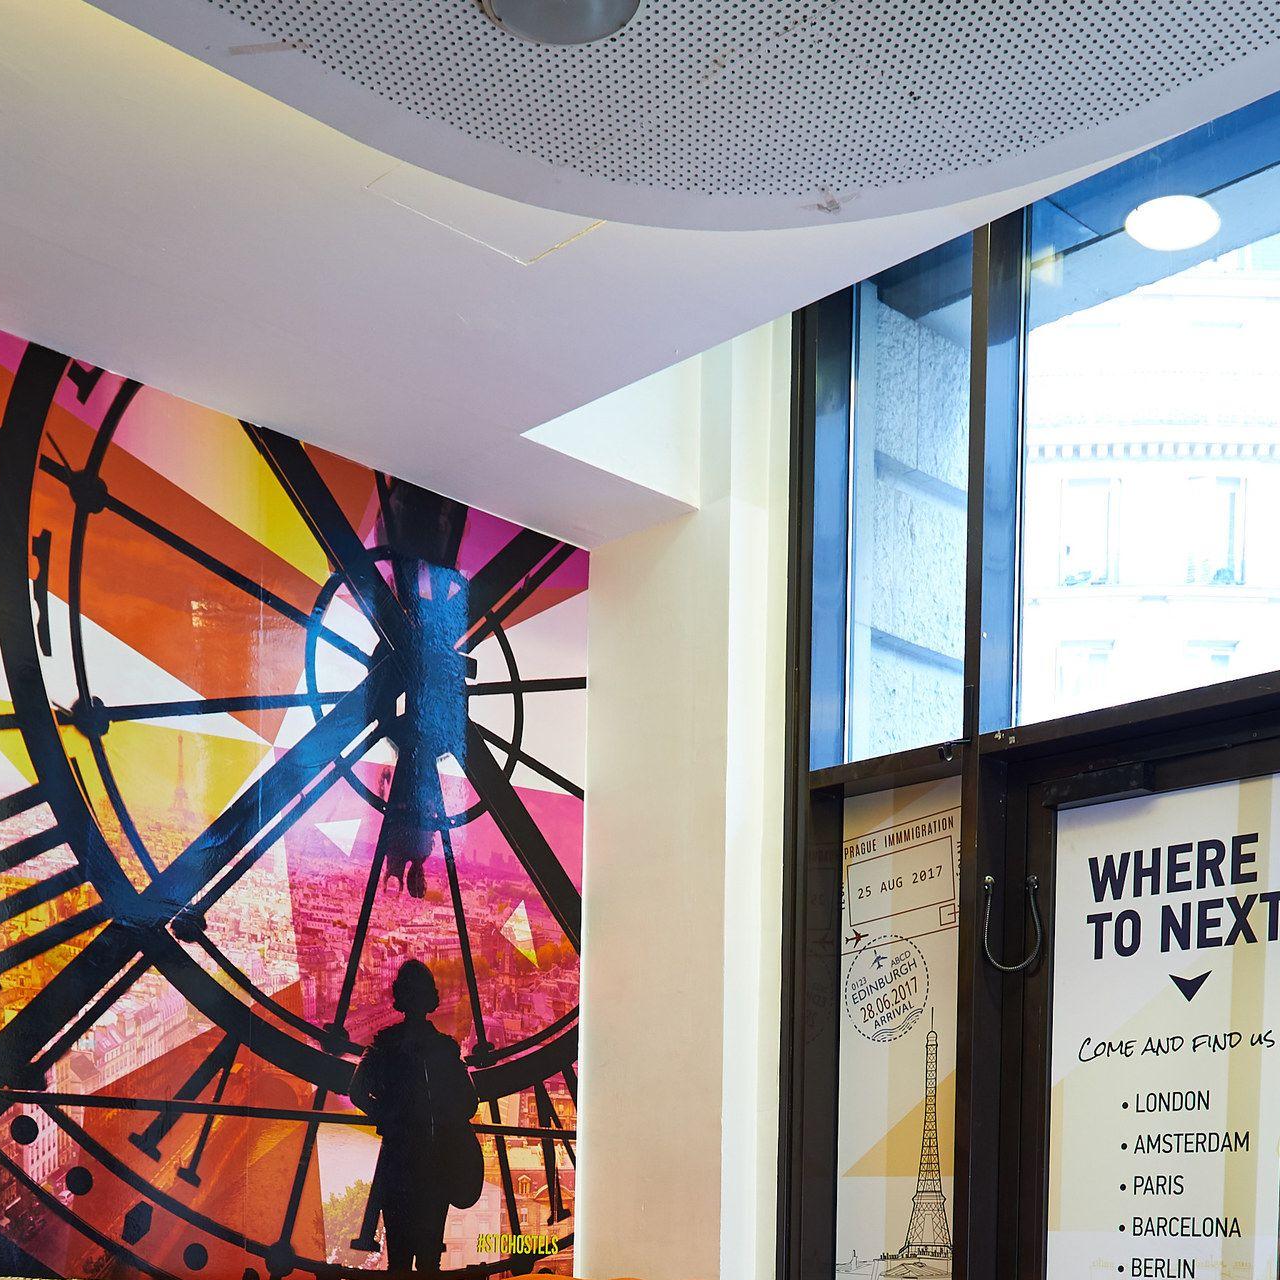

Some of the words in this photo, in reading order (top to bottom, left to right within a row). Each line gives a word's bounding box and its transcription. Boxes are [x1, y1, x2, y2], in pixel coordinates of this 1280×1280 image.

[844, 838, 876, 860] PRAGUE
[1087, 832, 1259, 903] WHERE
[858, 886, 872, 900] 25
[880, 877, 903, 893] AUG
[912, 865, 943, 884] 2017
[1086, 909, 1142, 960] TO
[890, 950, 911, 967] ABCD
[851, 957, 918, 1005] EDINBURGH
[851, 976, 867, 990] 0123
[860, 976, 920, 1024] 28.06.2017
[874, 1001, 914, 1029] ARRIVAL
[1078, 1036, 1135, 1063] COME
[1140, 1035, 1184, 1057] AND
[1192, 1030, 1244, 1053] FIND
[1135, 1090, 1210, 1113] LONDON
[1134, 1131, 1250, 1154] AMSTERDAM
[1133, 1175, 1185, 1196] PARIS
[1132, 1217, 1241, 1238] BARCELONA
[1131, 1258, 1196, 1279] BERLIN
